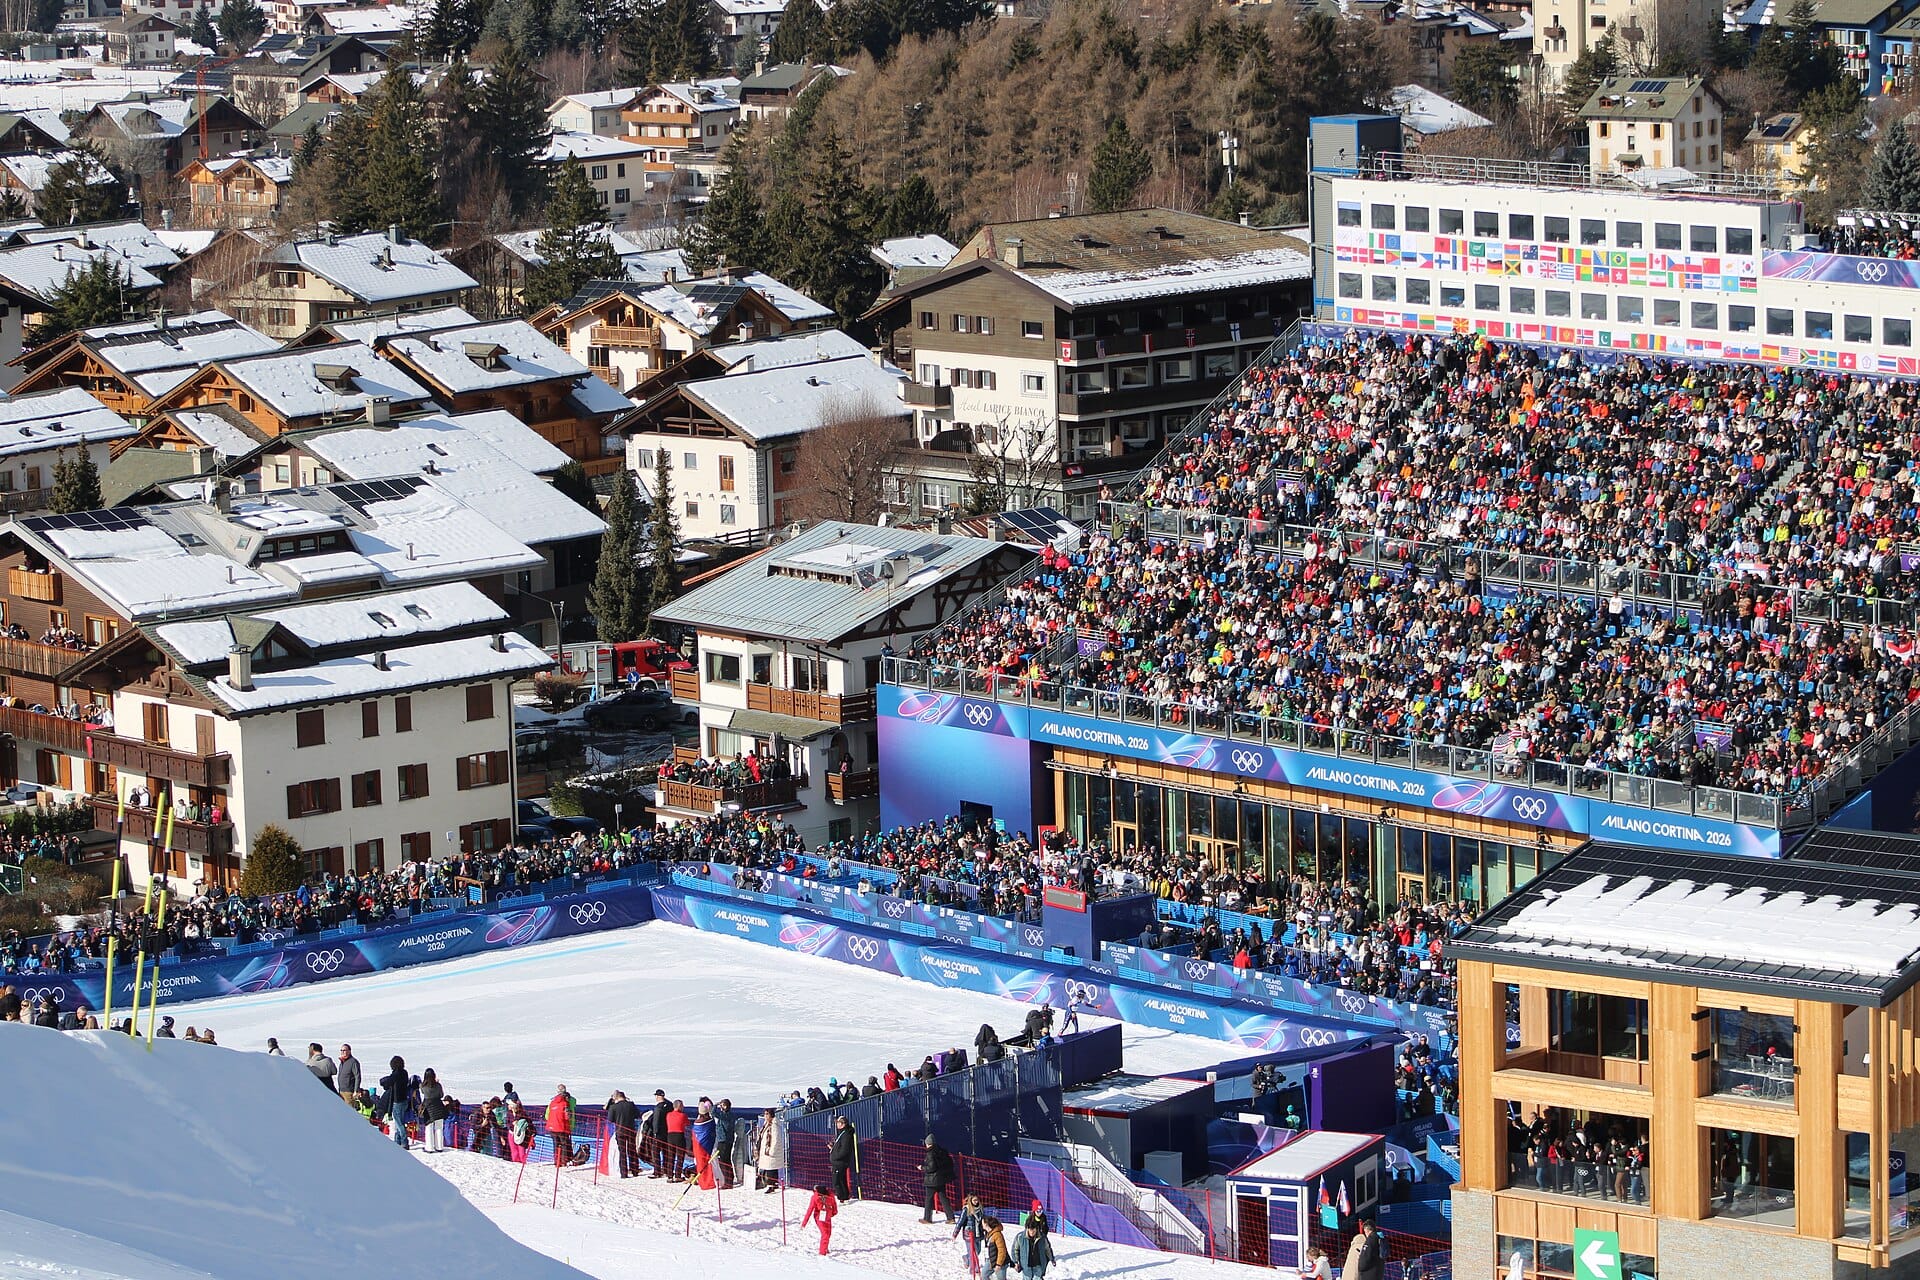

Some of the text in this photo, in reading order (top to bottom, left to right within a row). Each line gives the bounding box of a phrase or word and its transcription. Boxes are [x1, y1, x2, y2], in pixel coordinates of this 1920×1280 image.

[1014, 405, 1045, 417] BIANCO
[1040, 722, 1149, 750] MILANO CORTINA 2026
[1306, 767, 1425, 796] MILANO CORTINA 2026
[1601, 815, 1731, 846] MILANO CORTINA 2026
[714, 910, 769, 928] MILANO CORTINA
[398, 927, 473, 948] MILANO CORTINA
[427, 942, 445, 951] 2026
[921, 955, 981, 975] MILANO CORTINA
[943, 970, 958, 979] 2026
[162, 976, 202, 988] CORTINA
[1144, 1000, 1210, 1020] MILANO CORTINA
[1169, 1014, 1185, 1025] 2026
